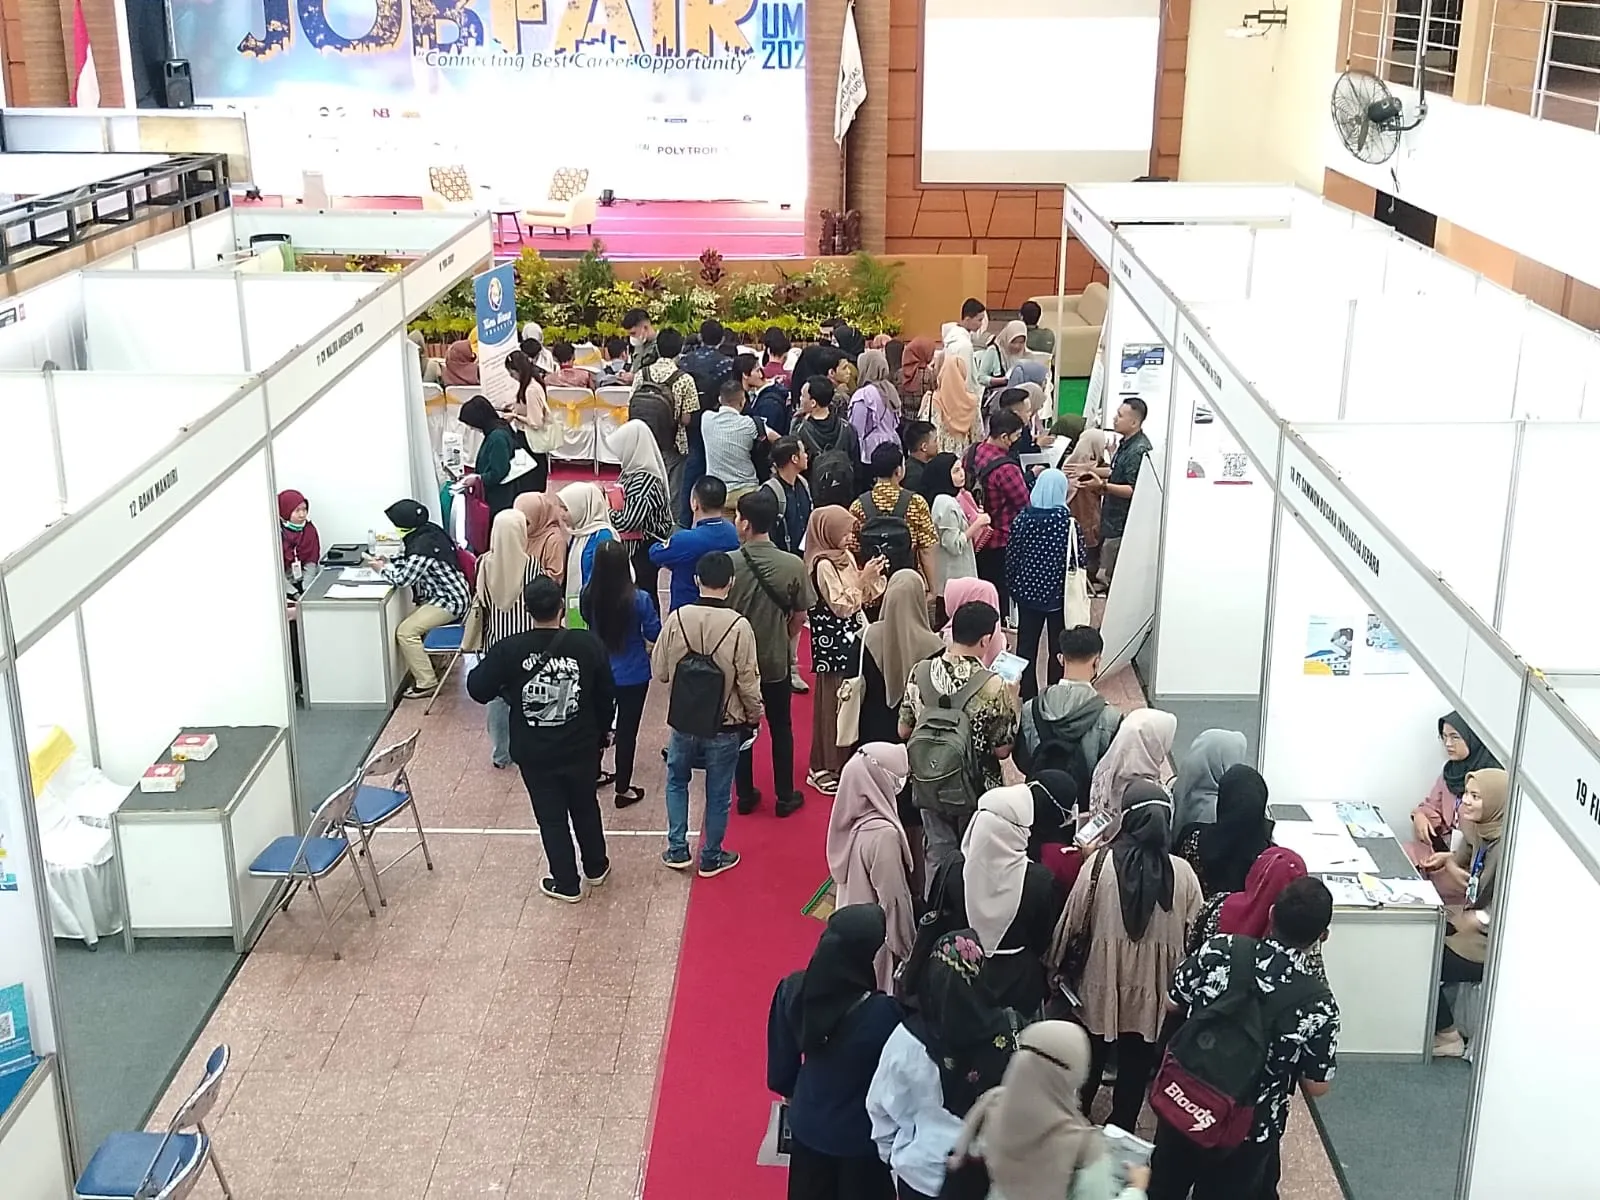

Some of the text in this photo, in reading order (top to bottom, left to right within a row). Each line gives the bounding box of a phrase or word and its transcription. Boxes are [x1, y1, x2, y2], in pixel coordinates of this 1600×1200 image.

[531, 53, 568, 68] Best
[129, 466, 179, 519] 12 BANK MANDIRI
[1296, 471, 1302, 488] PT
[1320, 497, 1337, 529] BUSANA
[1337, 516, 1362, 557] INDONESIA
[1361, 544, 1380, 577] JEPARA
[1576, 777, 1588, 807] 19
[1163, 1081, 1217, 1132] Bloods
